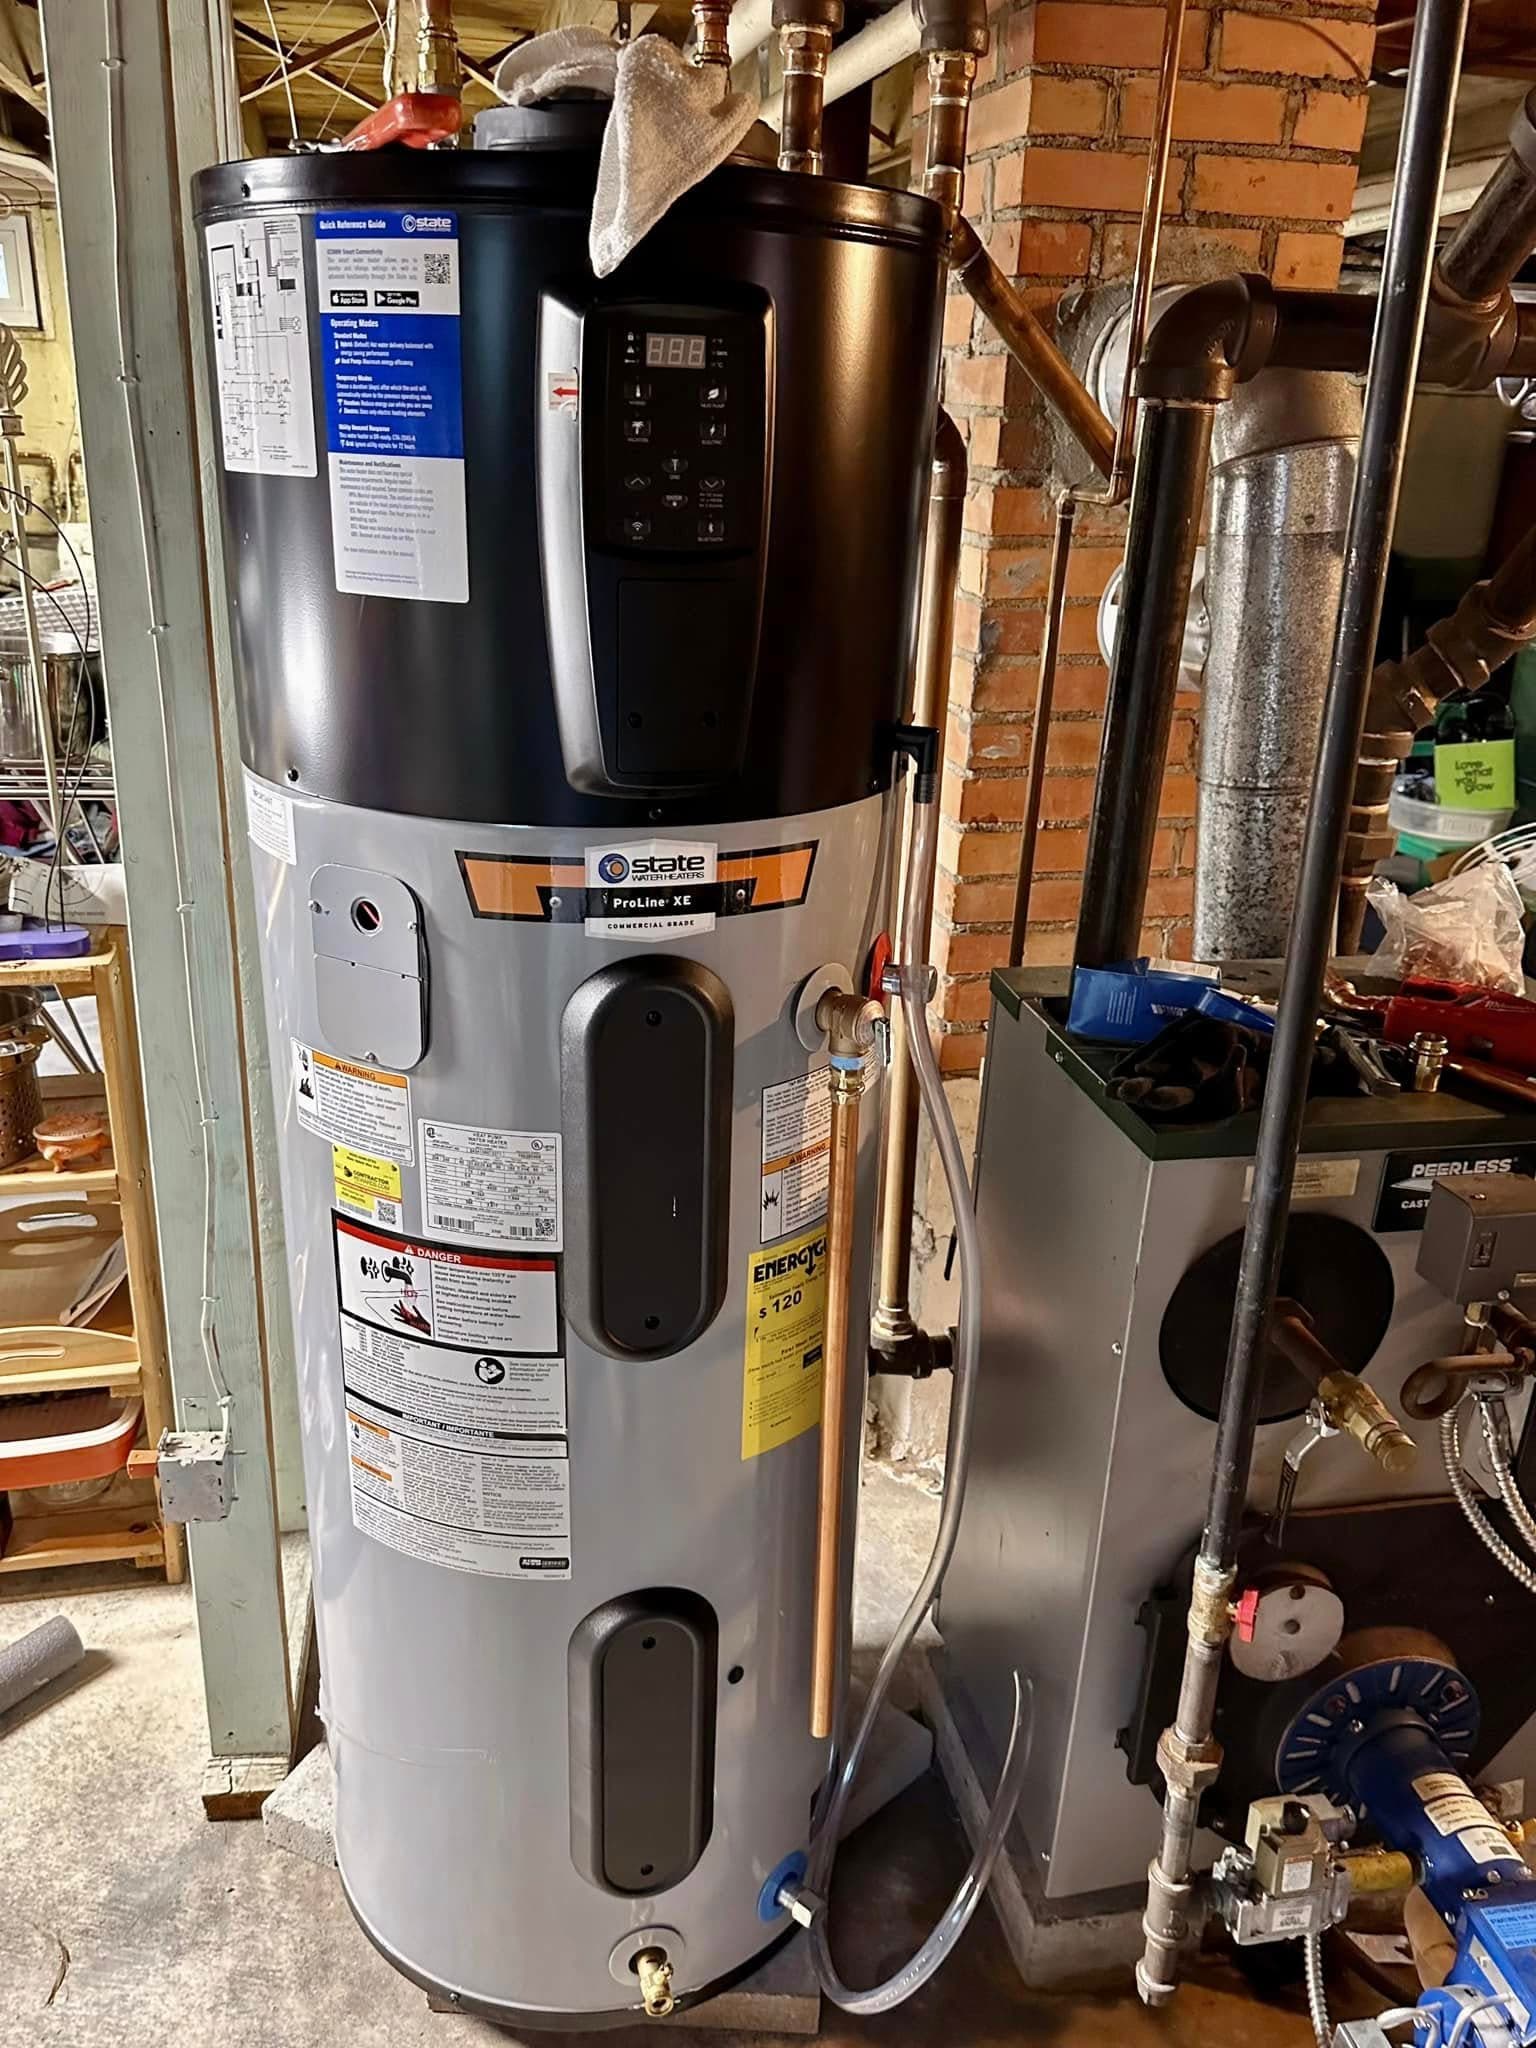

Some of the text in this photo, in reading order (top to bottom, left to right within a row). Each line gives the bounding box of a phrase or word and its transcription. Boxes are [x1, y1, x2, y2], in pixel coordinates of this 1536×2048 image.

[416, 217, 452, 228] state
[1454, 760, 1483, 770] Love
[1464, 766, 1493, 777] what
[632, 854, 705, 873] state
[632, 871, 705, 882] WATER HEATERS
[613, 895, 692, 909] ProLine XE
[607, 919, 695, 930] COMMERCIAL GRADE
[341, 1062, 376, 1081] WARNING
[1411, 1158, 1513, 1178] PEERLESS
[1401, 1199, 1430, 1209] CAST
[416, 1247, 462, 1264] DANGER
[772, 1290, 803, 1313] 120
[401, 1413, 440, 1429] IMPORTANT
[446, 1425, 495, 1438] IMPORTANTE
